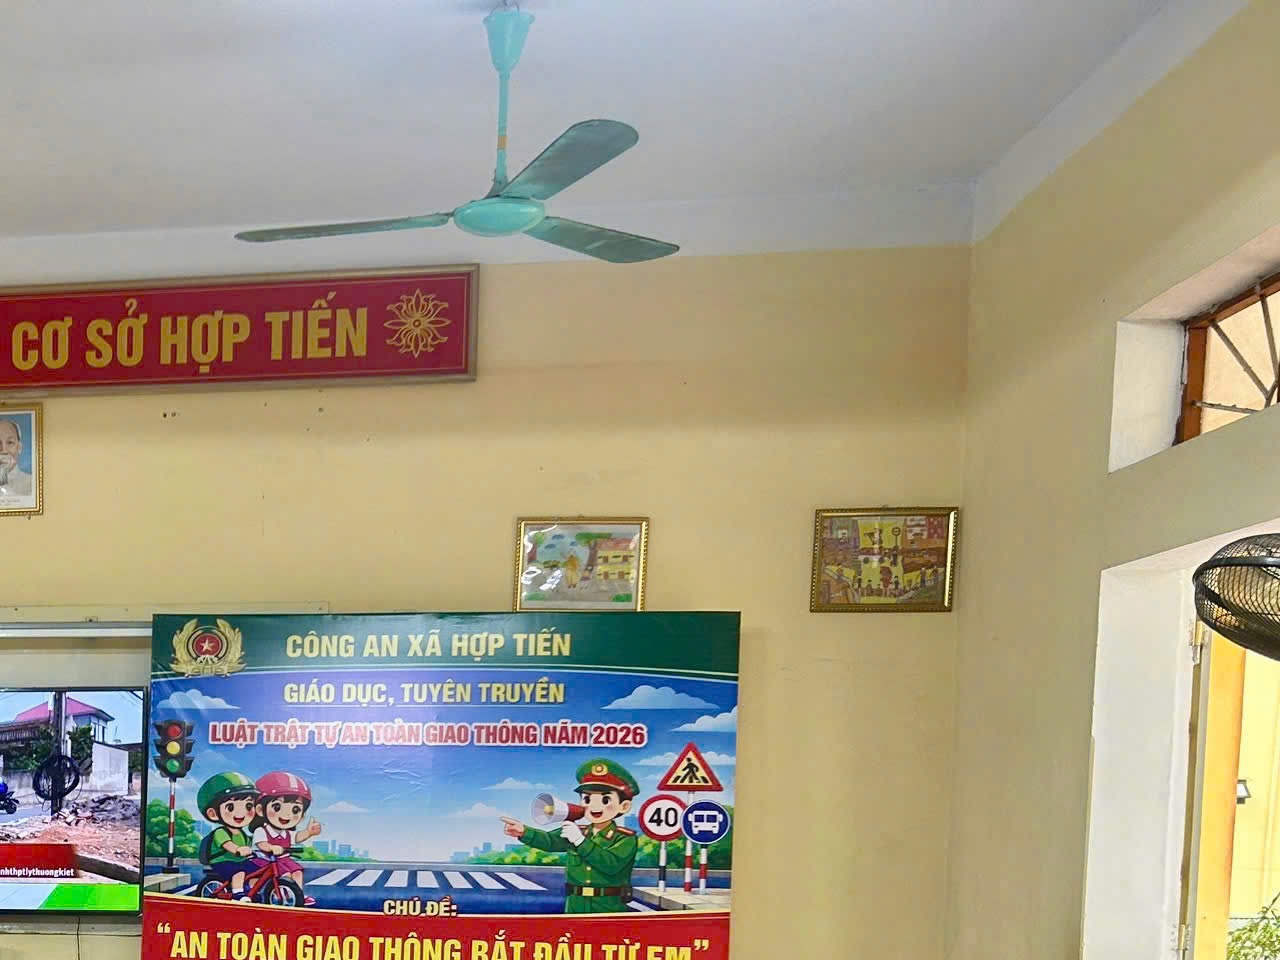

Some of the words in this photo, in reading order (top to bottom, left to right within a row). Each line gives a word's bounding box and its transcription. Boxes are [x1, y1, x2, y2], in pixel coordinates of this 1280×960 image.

[11, 316, 73, 371] CƠ
[85, 298, 148, 369] SỞ
[159, 310, 251, 374] HỢP
[265, 291, 368, 361] TIẾN
[286, 631, 355, 658] CÔNG
[363, 634, 398, 658] AN
[407, 629, 442, 657] XÃ
[451, 631, 505, 661] HỢP
[513, 627, 571, 657] TIẾN
[283, 678, 336, 704] GIÁO
[342, 682, 395, 707] DỤC,
[401, 678, 472, 704] TUYÊN
[478, 677, 565, 704] TRUYỀN
[210, 719, 258, 747] LUẬT
[263, 719, 310, 748] TRẬT
[315, 721, 341, 748] TỰ
[341, 723, 368, 744] AN
[372, 719, 421, 744] TOÀN
[424, 724, 470, 744] GIAO
[474, 720, 538, 745] THÔNG
[543, 720, 588, 745] NĂM
[592, 725, 645, 745] 2026
[648, 807, 678, 828] 40
[424, 896, 457, 917] ĐỀ:
